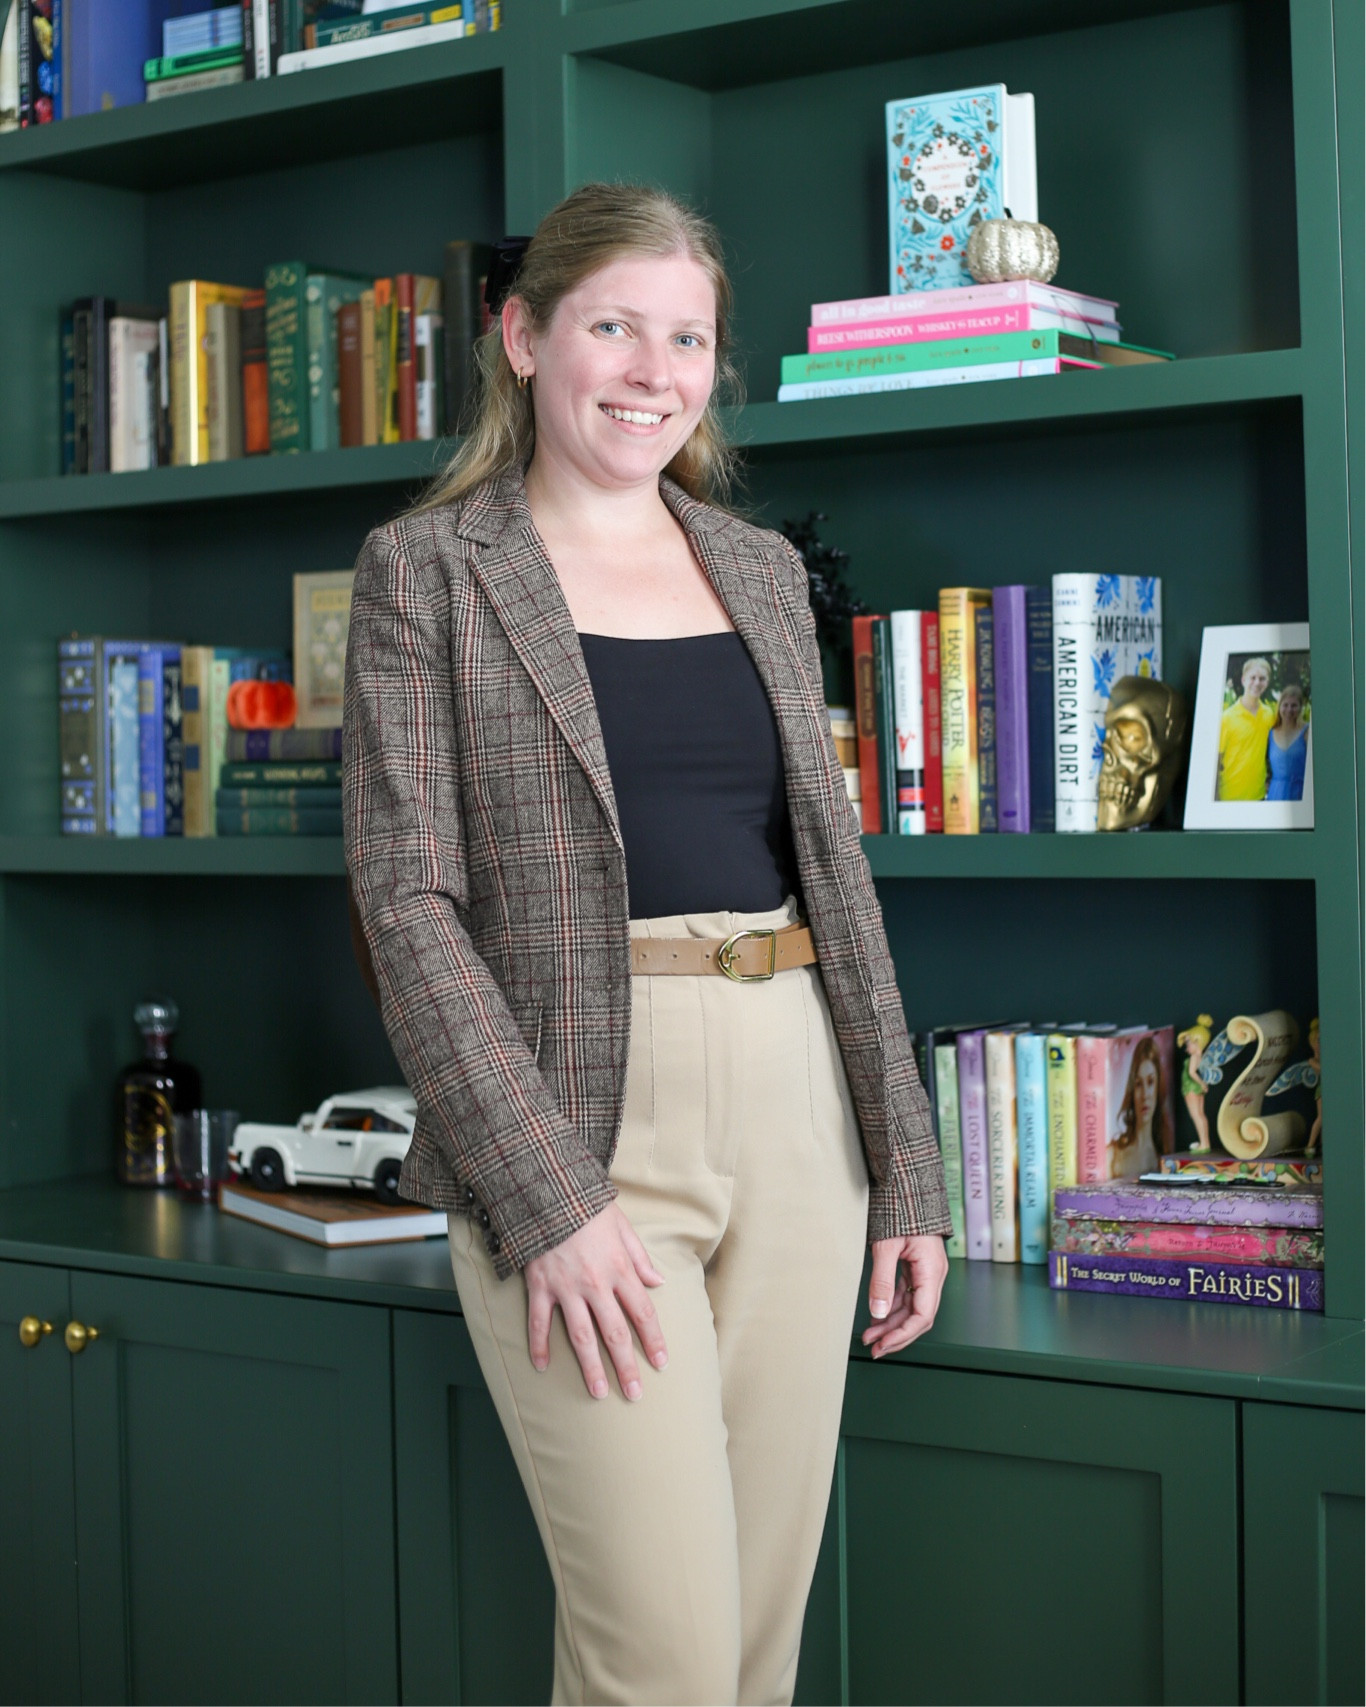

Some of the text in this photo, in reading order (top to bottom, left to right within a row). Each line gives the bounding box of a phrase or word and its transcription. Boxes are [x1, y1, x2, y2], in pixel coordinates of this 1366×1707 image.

[821, 298, 927, 320] all in good taste
[967, 315, 1001, 329] TEACUP
[817, 331, 844, 345] REESE
[846, 324, 914, 342] WITHERSPOON
[917, 319, 957, 333] WHISKEY
[804, 384, 854, 400] THINGS
[880, 379, 915, 393] LOVE
[1096, 615, 1155, 643] AMERICAN
[980, 643, 993, 689] ROWLING
[947, 629, 964, 751] HARRY POTTER
[1058, 637, 1079, 786] AMERICAN DIRT
[968, 1115, 980, 1147] LOST
[992, 1111, 1005, 1181] SORCERER
[1024, 1111, 1036, 1169] IMMORTAL
[1054, 1113, 1066, 1180] ENCHANTED
[1085, 1114, 1097, 1170] CHARMED
[970, 1152, 982, 1200] QUEEN
[1025, 1171, 1037, 1208] REALM
[994, 1186, 1006, 1220] KING
[1206, 1201, 1236, 1218] Journal
